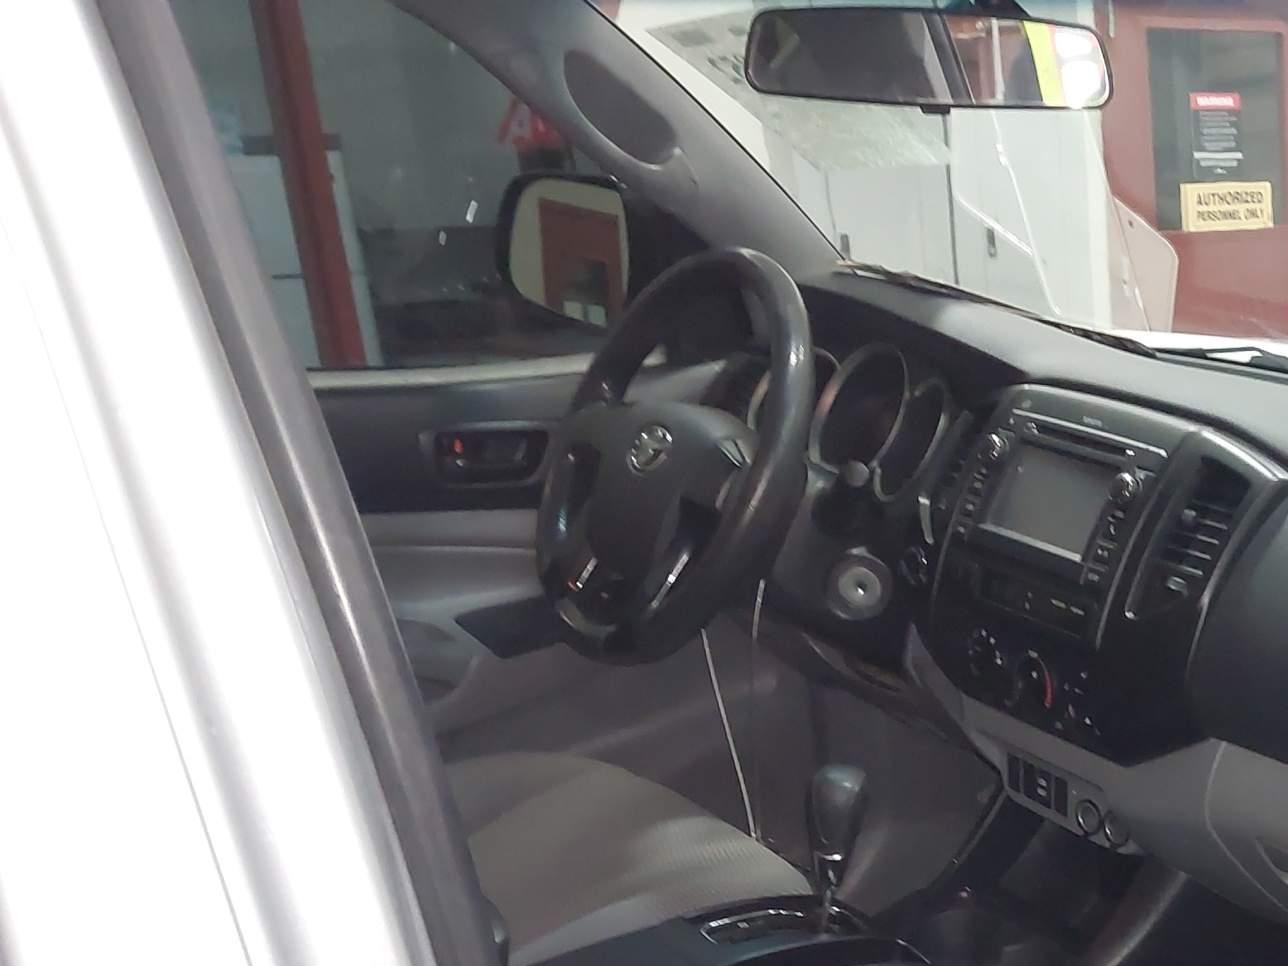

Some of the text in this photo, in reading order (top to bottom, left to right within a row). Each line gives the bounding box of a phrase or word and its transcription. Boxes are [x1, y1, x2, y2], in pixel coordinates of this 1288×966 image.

[1196, 191, 1264, 206] AUTHORIZED
[1196, 207, 1264, 221] PERSONNEL ONLY
